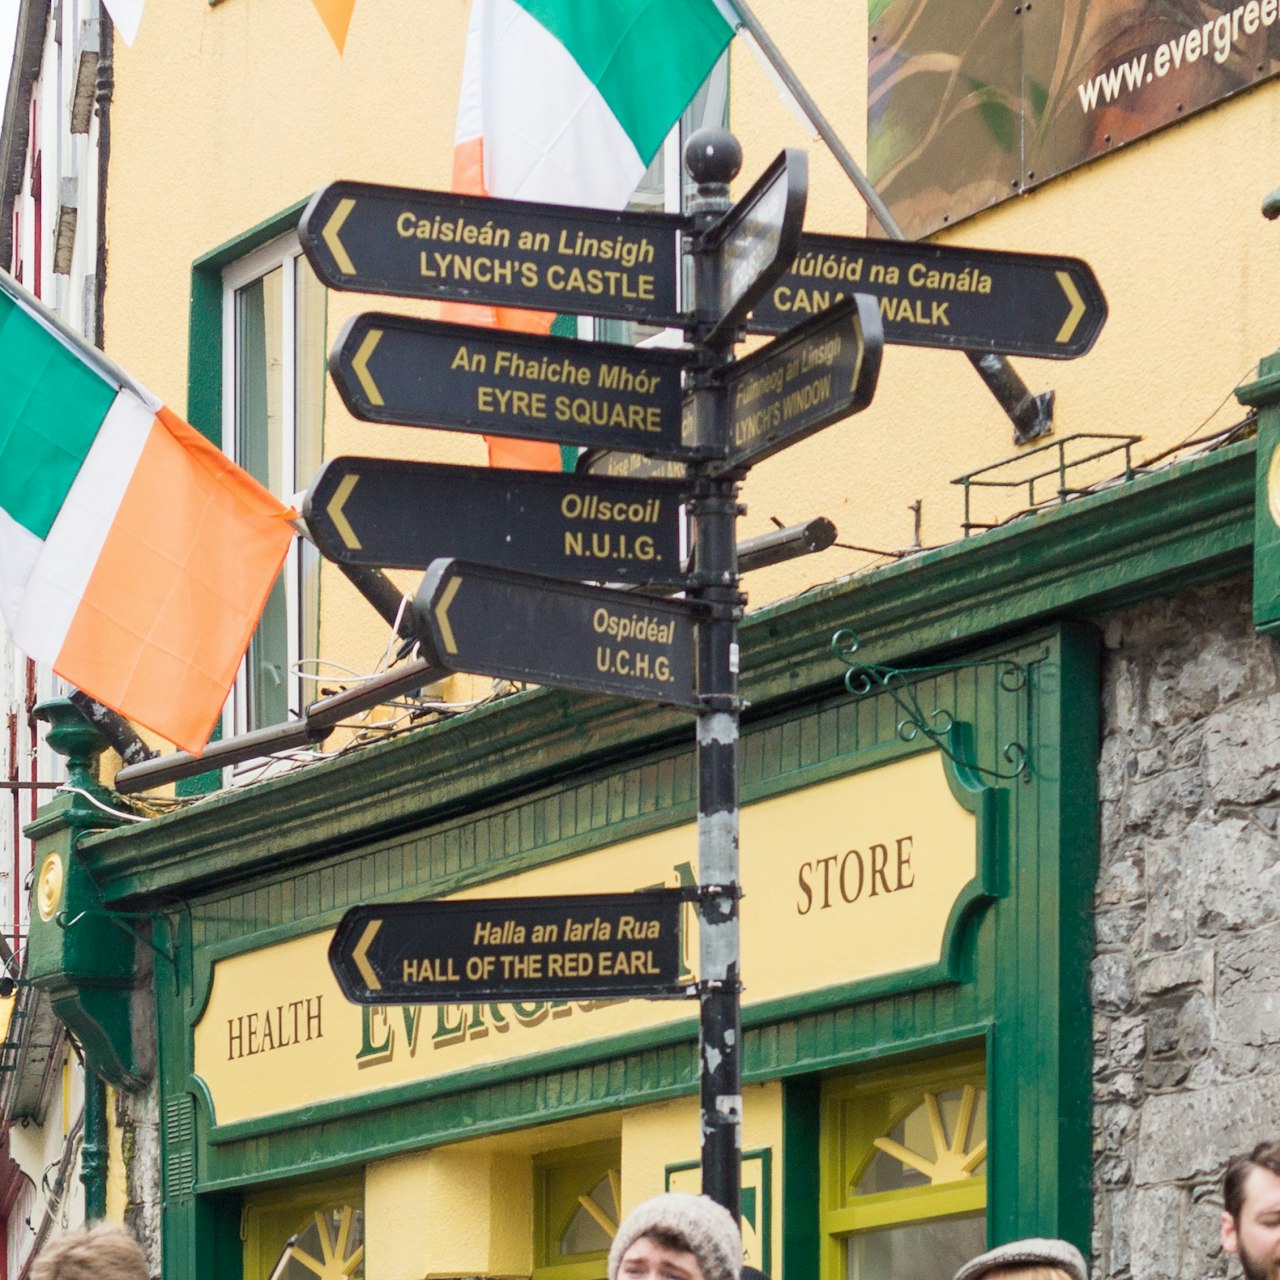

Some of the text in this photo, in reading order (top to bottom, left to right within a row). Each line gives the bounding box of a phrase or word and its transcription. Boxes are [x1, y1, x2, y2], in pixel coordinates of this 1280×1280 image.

[396, 210, 656, 266] Caisleán an Linsigh
[419, 250, 656, 301] LYNCH'S CASTLE
[868, 263, 900, 286] na
[908, 262, 993, 295] Canála
[772, 285, 855, 315] CANA
[450, 345, 661, 395] An Fhaiche Mhór
[786, 359, 800, 382] an
[477, 385, 547, 420] EYRE
[553, 394, 663, 433] SQUARE
[783, 374, 832, 421] WINDOW
[561, 494, 661, 525] Ollscoil
[563, 530, 663, 563] N.U.I.G.
[592, 607, 676, 646] Ospidéal
[596, 647, 675, 685] U.C.H.G.
[226, 993, 324, 1061] HEALTH
[795, 834, 917, 917] STORE
[473, 915, 661, 948] Halla an Iarla Rua
[402, 949, 661, 984] HALL OF THE RED EARL
